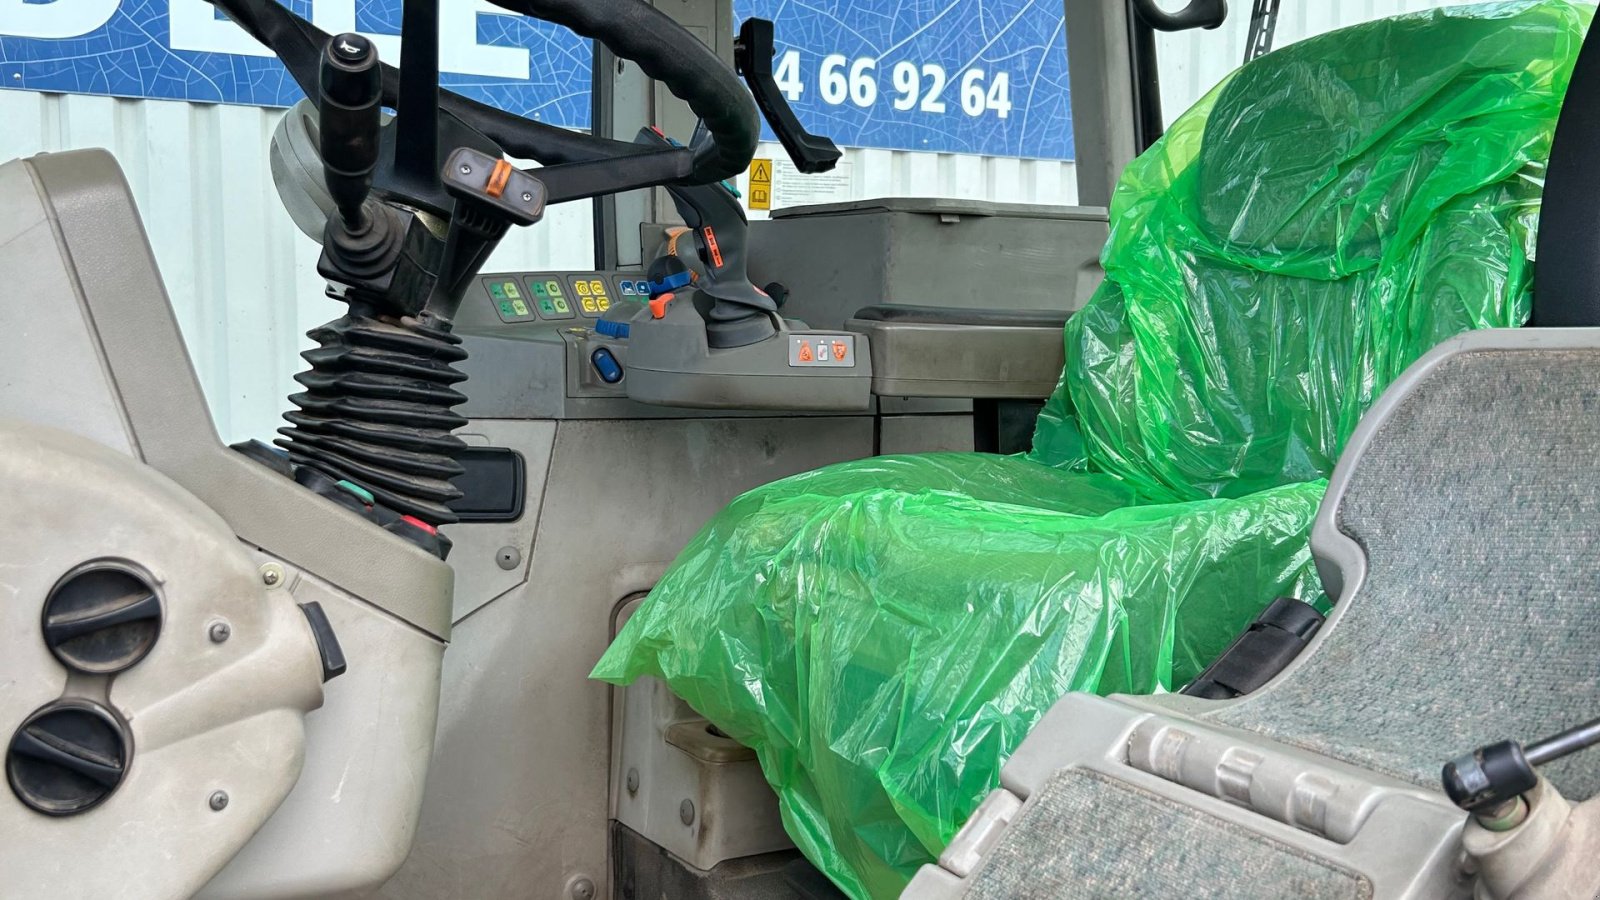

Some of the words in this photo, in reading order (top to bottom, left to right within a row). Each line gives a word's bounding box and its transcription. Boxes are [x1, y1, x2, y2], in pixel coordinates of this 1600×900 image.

[818, 54, 878, 107] 66
[892, 60, 946, 113] 92
[960, 68, 1012, 119] 64
